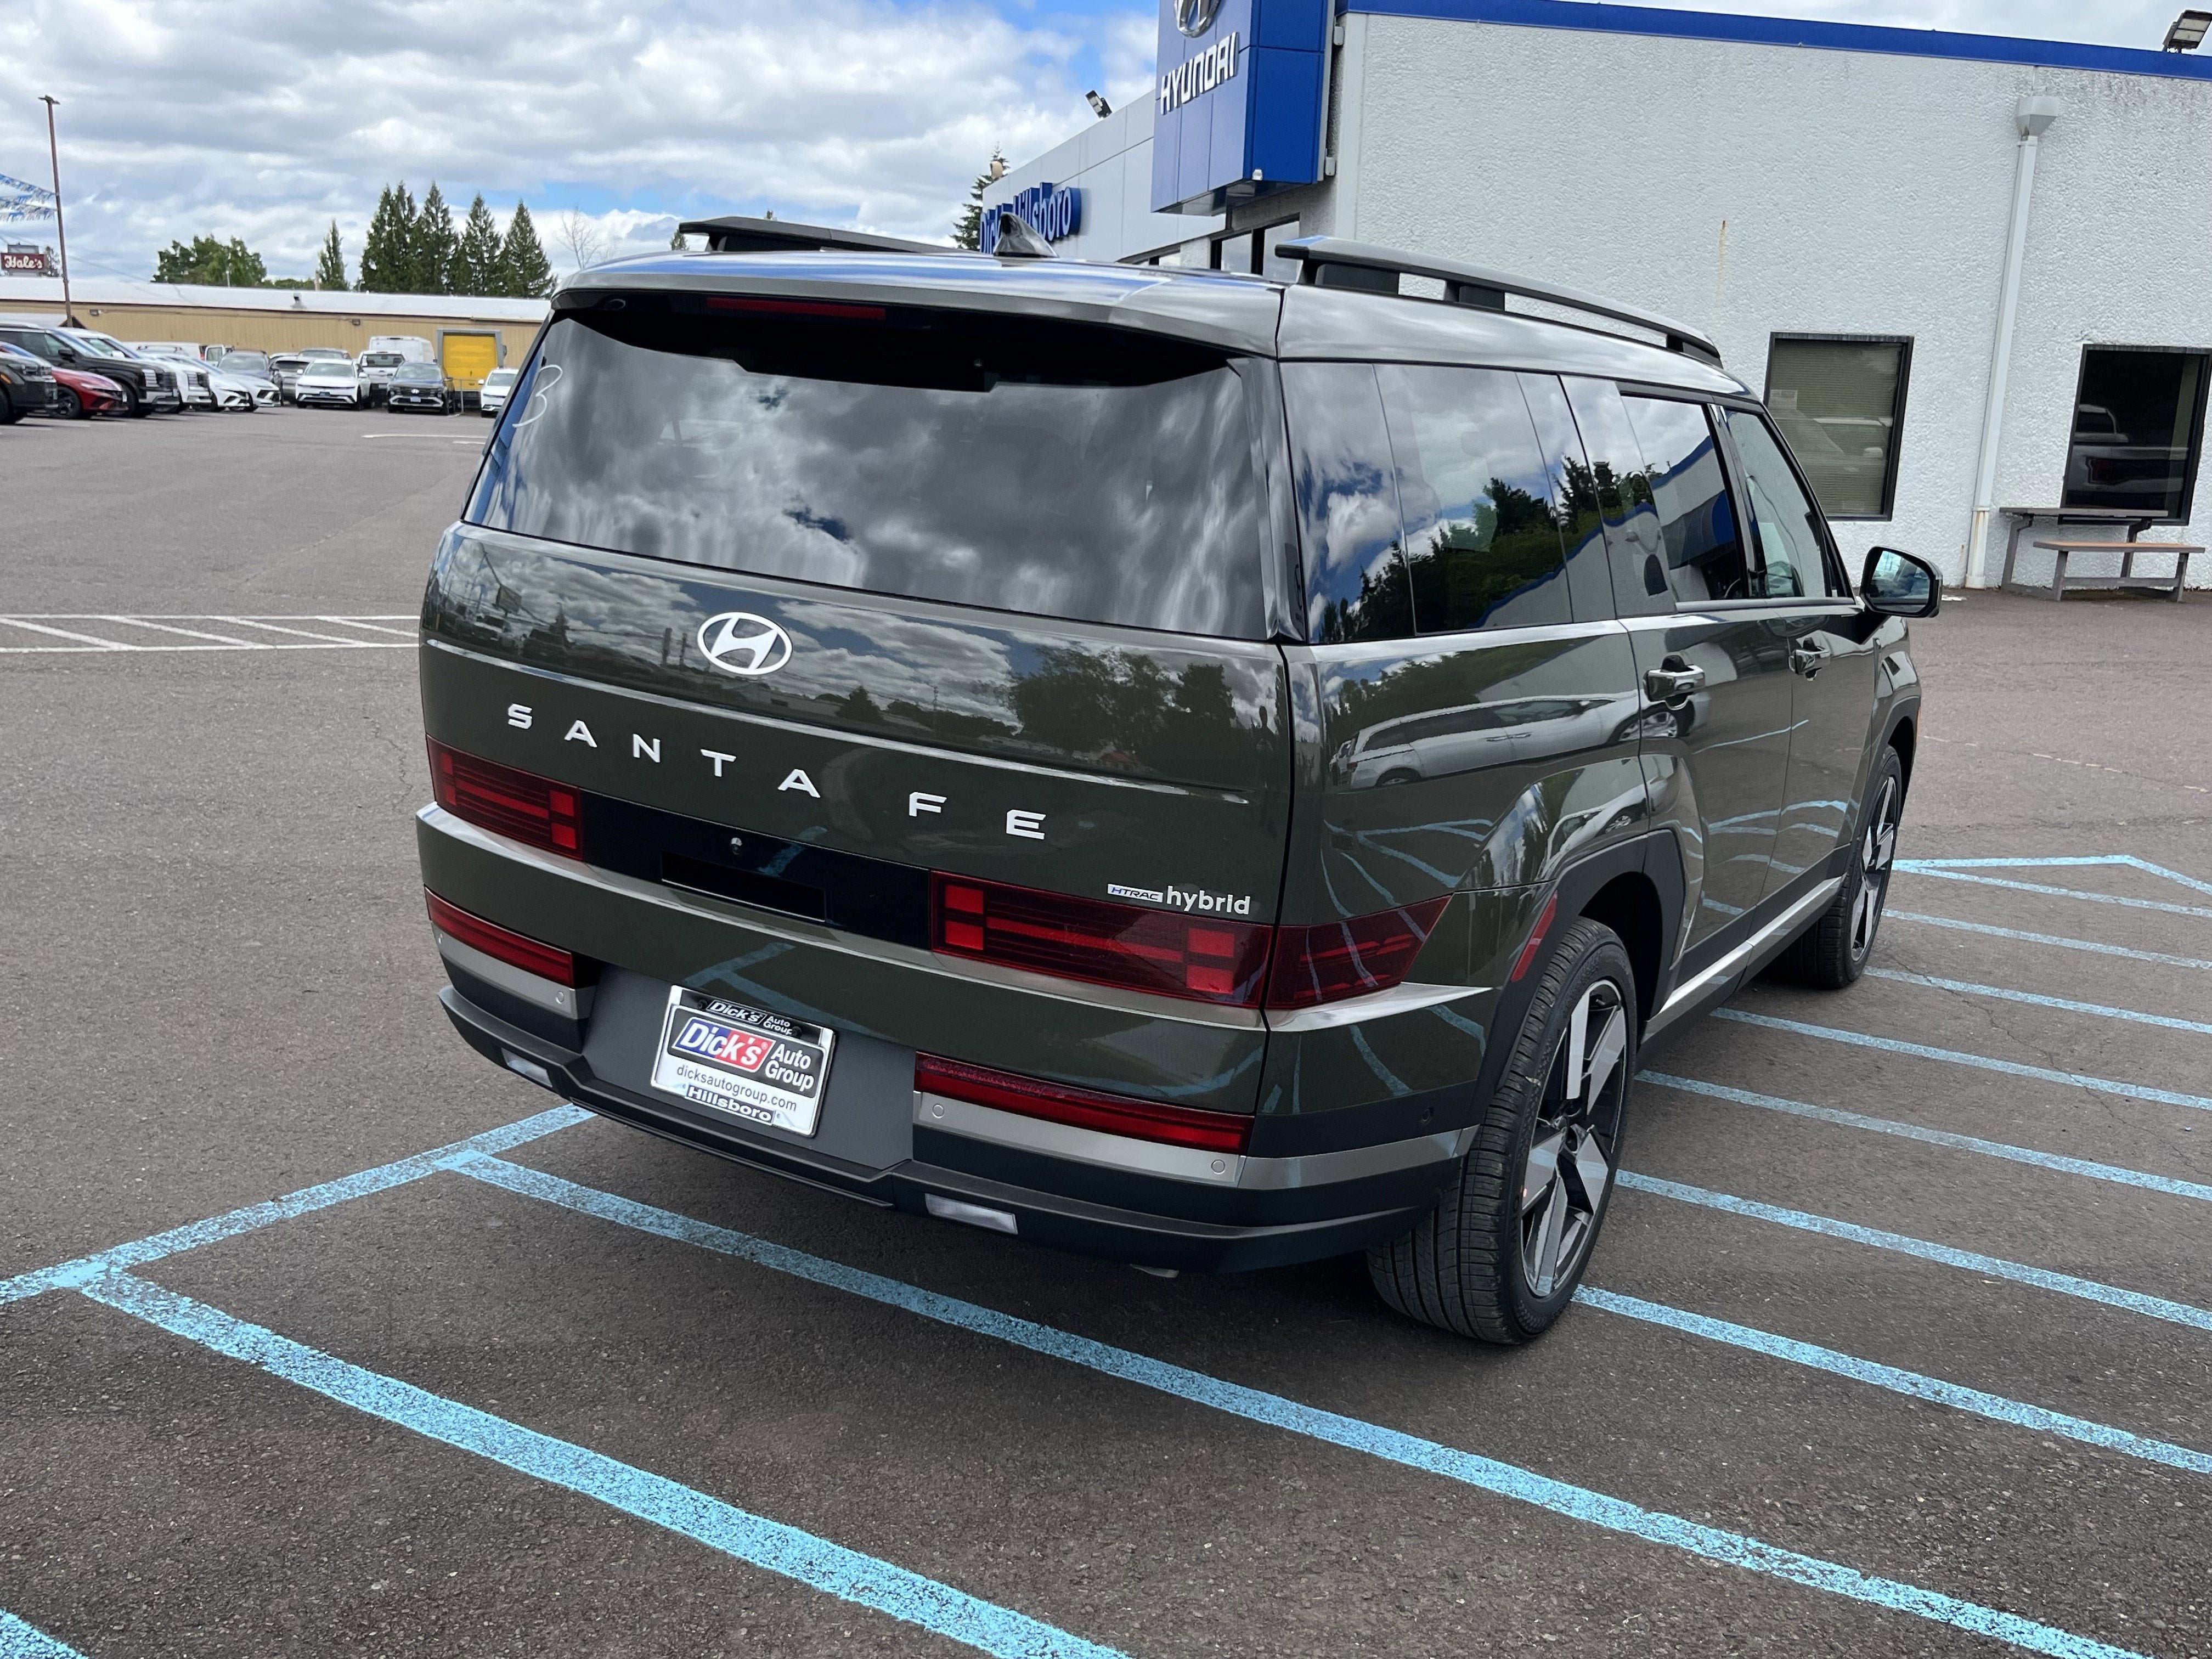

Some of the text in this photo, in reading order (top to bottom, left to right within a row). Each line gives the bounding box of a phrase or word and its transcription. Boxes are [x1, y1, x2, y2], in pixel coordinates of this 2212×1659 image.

[1160, 32, 1239, 115] HYUNDAI
[4, 255, 43, 269] Hale's
[507, 703, 1046, 840] SANTA FE
[1110, 885, 1250, 915] HTRAC hybrid
[710, 1002, 761, 1023] Dick's
[767, 1015, 791, 1028] Auto
[680, 1022, 763, 1065] Dick's
[771, 1043, 811, 1069] Auto
[677, 1065, 797, 1111] dicksautogroup.com
[765, 1060, 815, 1091] Group
[687, 1086, 772, 1121] Hillsboro
